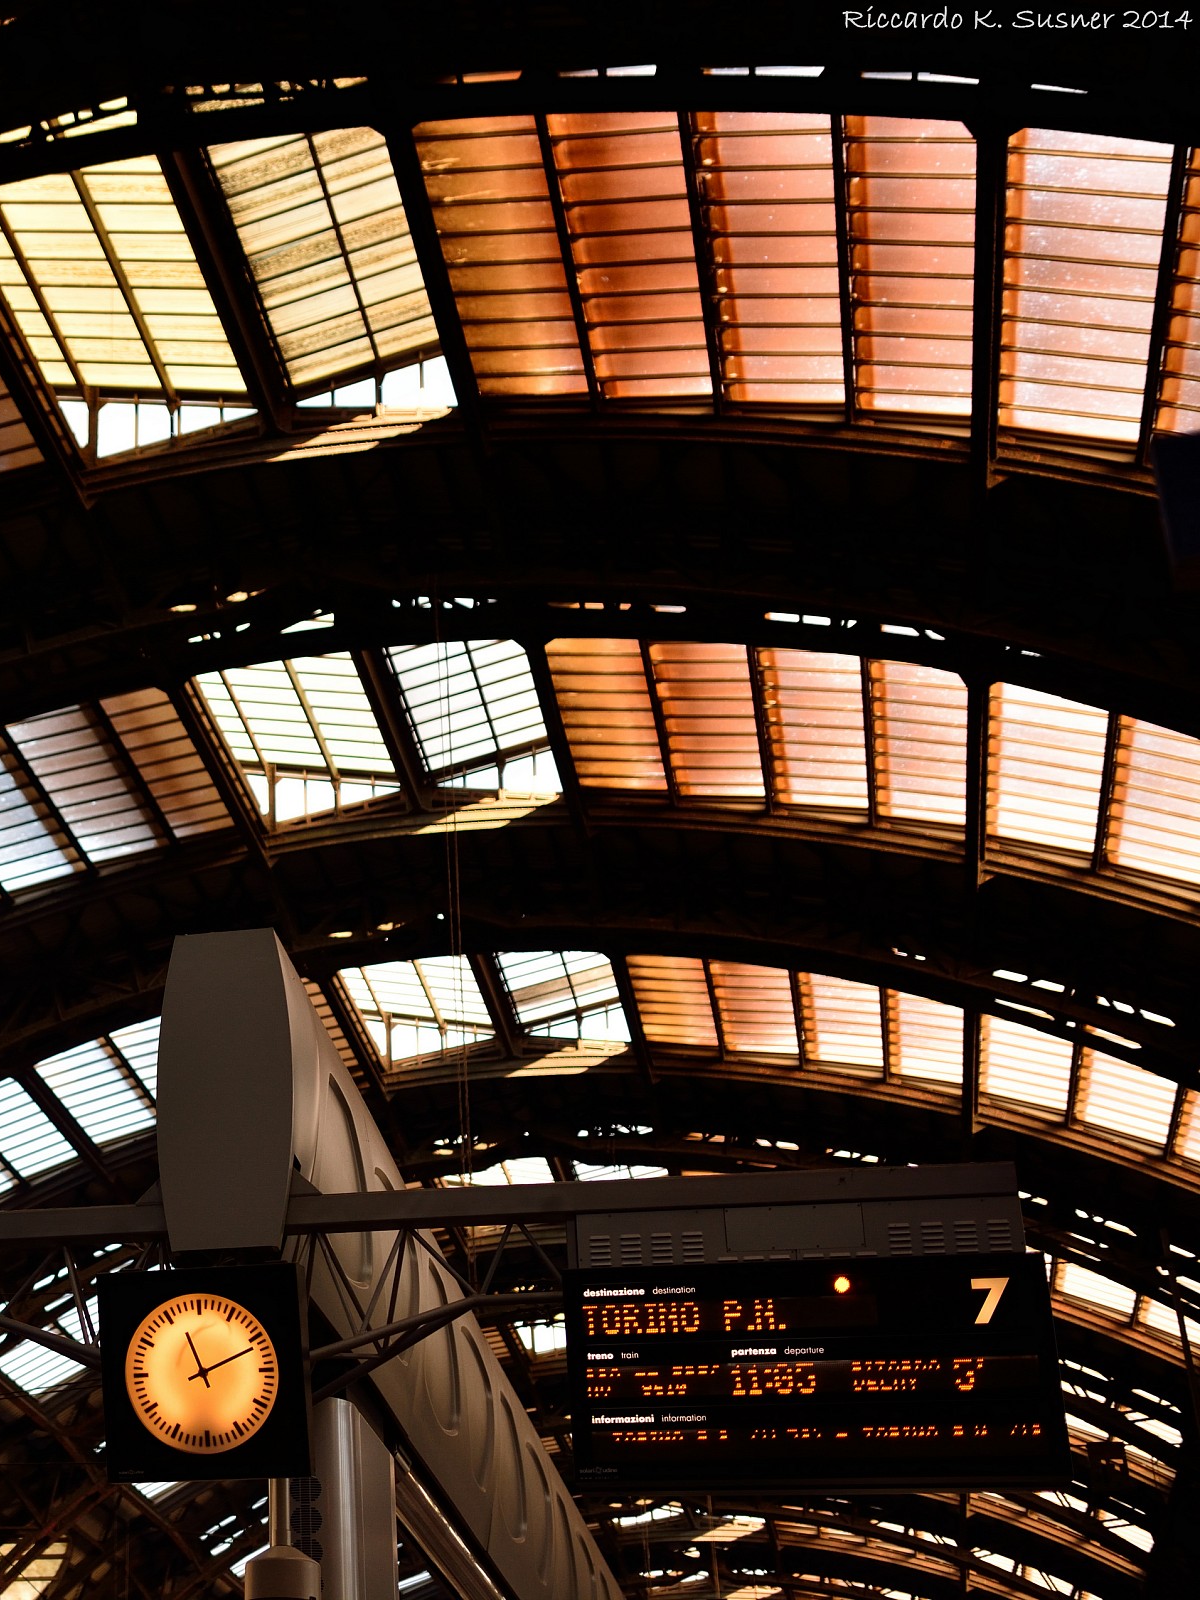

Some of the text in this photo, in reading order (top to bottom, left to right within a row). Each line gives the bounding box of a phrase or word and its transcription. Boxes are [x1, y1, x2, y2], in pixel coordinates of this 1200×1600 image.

[582, 1284, 696, 1298] destinazione destination
[970, 1277, 1010, 1325] 7
[582, 1302, 700, 1336] TORINO
[586, 1351, 639, 1361] treno train
[730, 1345, 825, 1359] partenza departure
[591, 1412, 707, 1425] informazioni information
